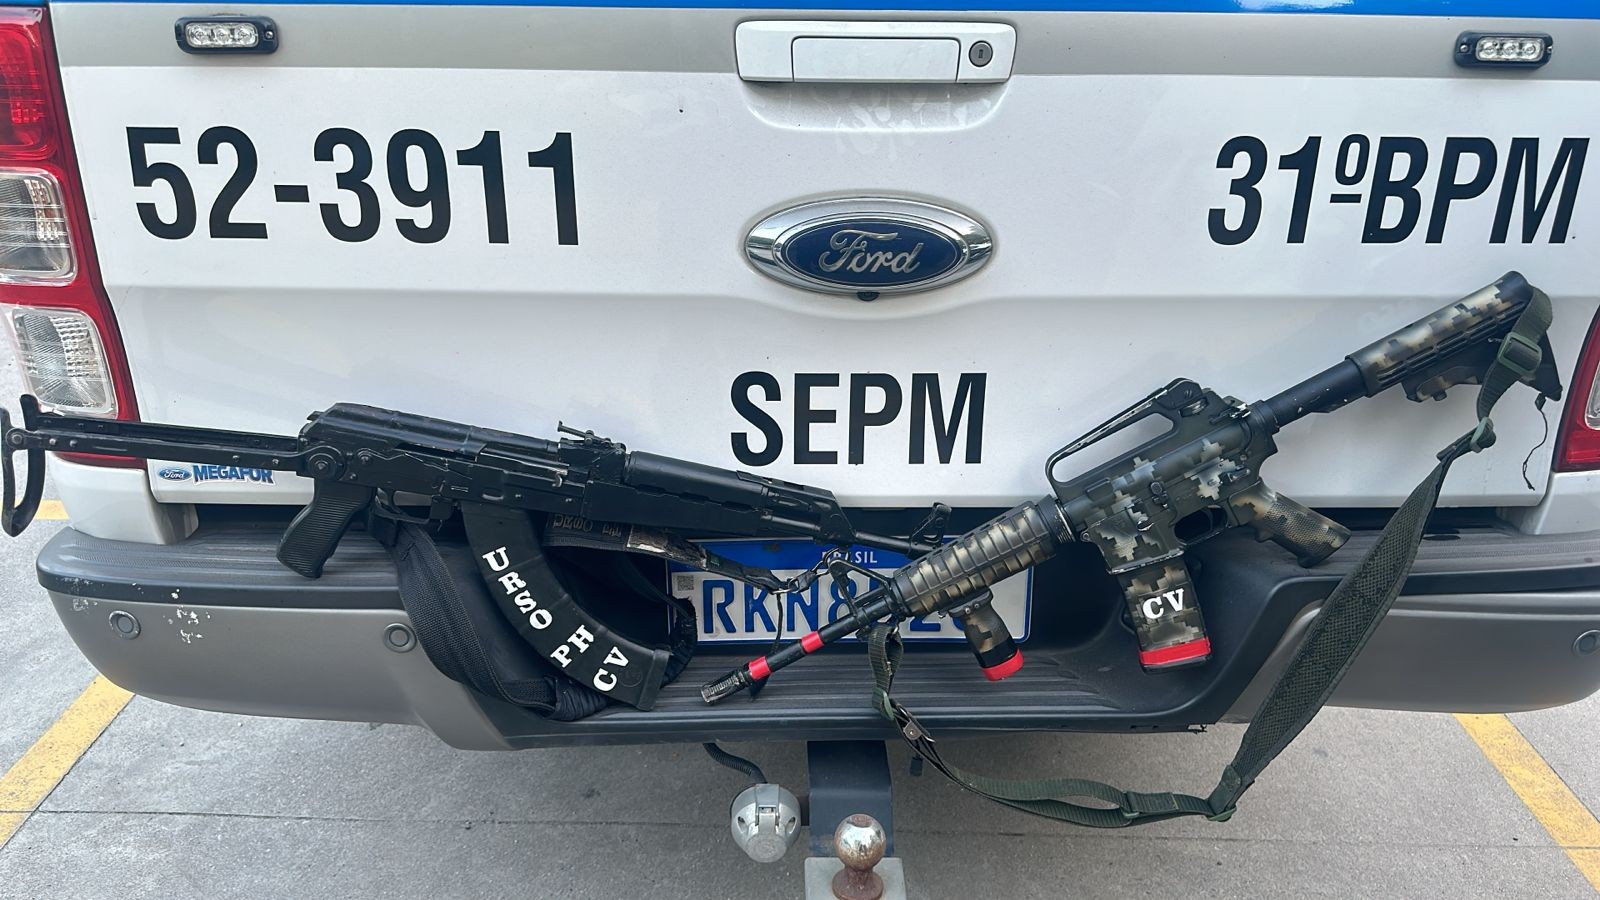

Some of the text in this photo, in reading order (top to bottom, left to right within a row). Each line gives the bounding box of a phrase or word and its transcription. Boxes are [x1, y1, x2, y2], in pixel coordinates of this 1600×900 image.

[126, 125, 579, 246] 52-3911
[819, 229, 925, 274] Ford
[730, 370, 988, 467] SEPM
[163, 469, 186, 480] Ford
[482, 546, 629, 692] URSO PH CV
[1142, 588, 1185, 619] CV
